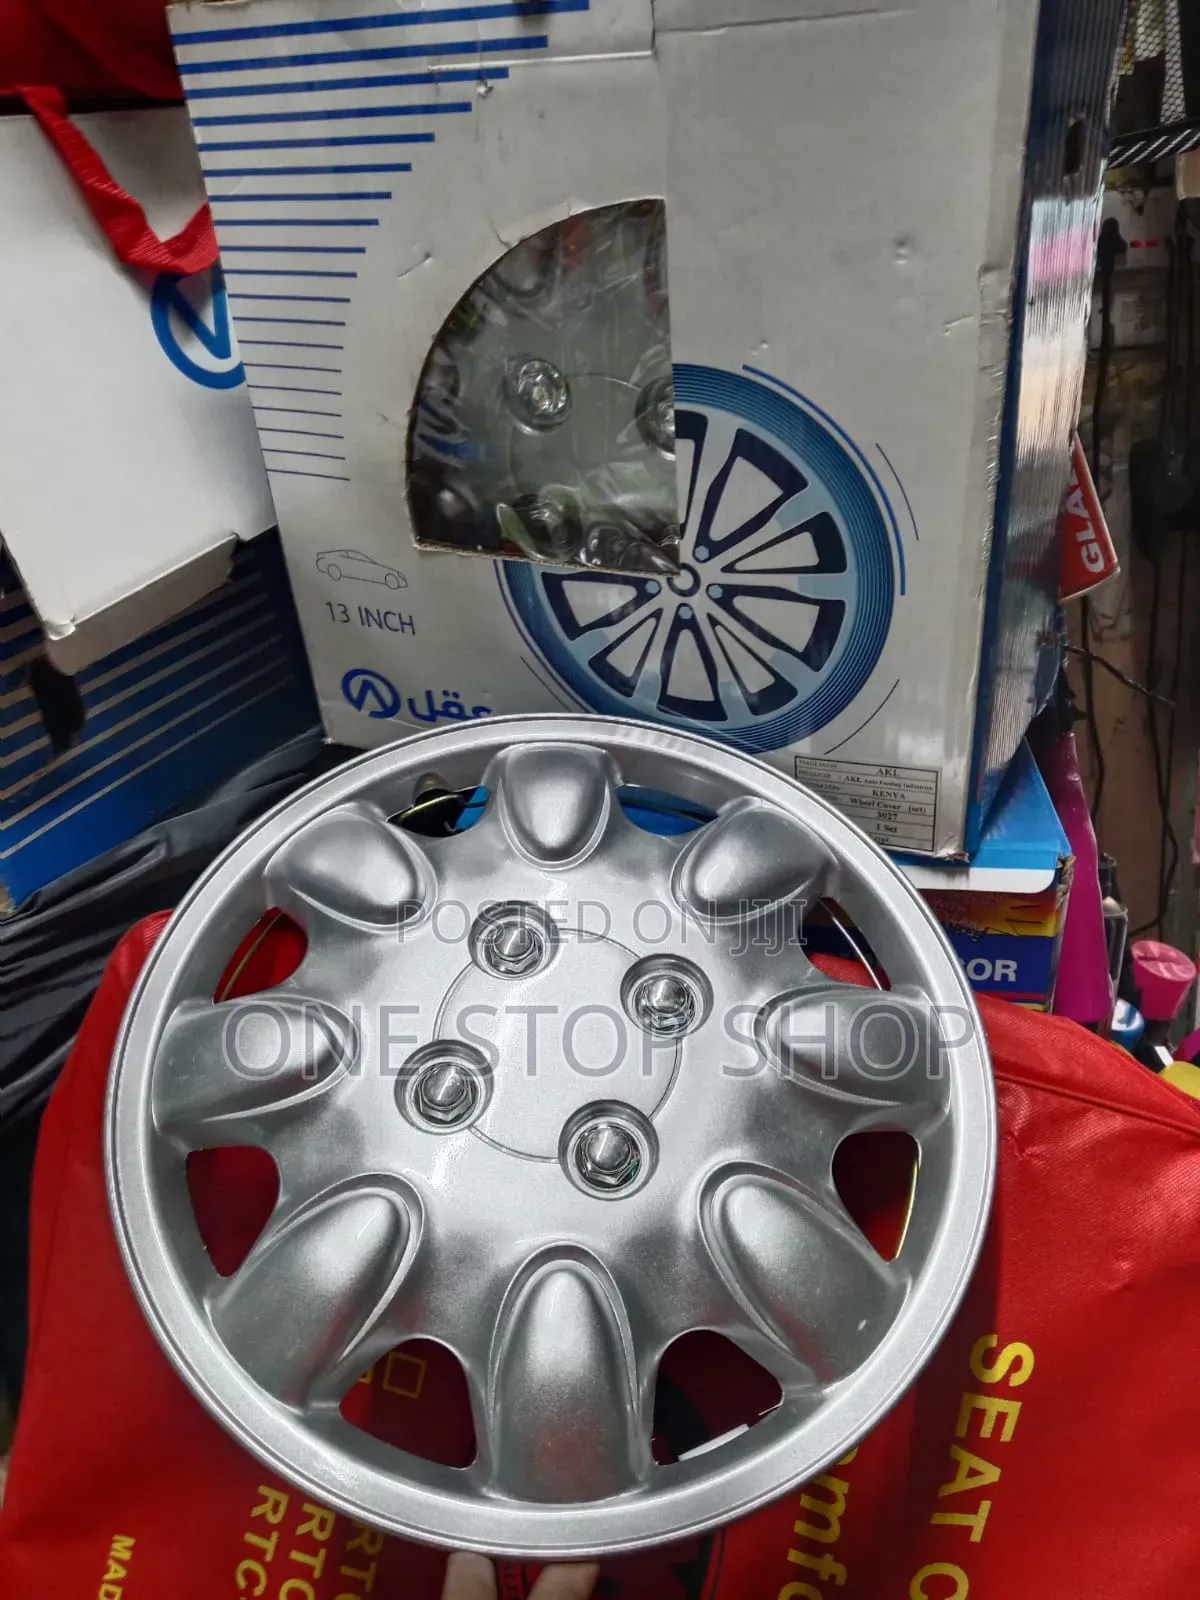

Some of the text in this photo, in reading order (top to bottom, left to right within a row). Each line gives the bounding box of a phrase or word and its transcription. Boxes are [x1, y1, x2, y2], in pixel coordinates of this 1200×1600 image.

[326, 601, 416, 636] 13 INCH
[876, 768, 899, 777] AKL
[872, 789, 906, 800] KENYA
[849, 798, 875, 808] Wheel
[877, 801, 903, 811] Cover
[961, 957, 1018, 982] OR
[930, 1333, 1035, 1543] SEAT
